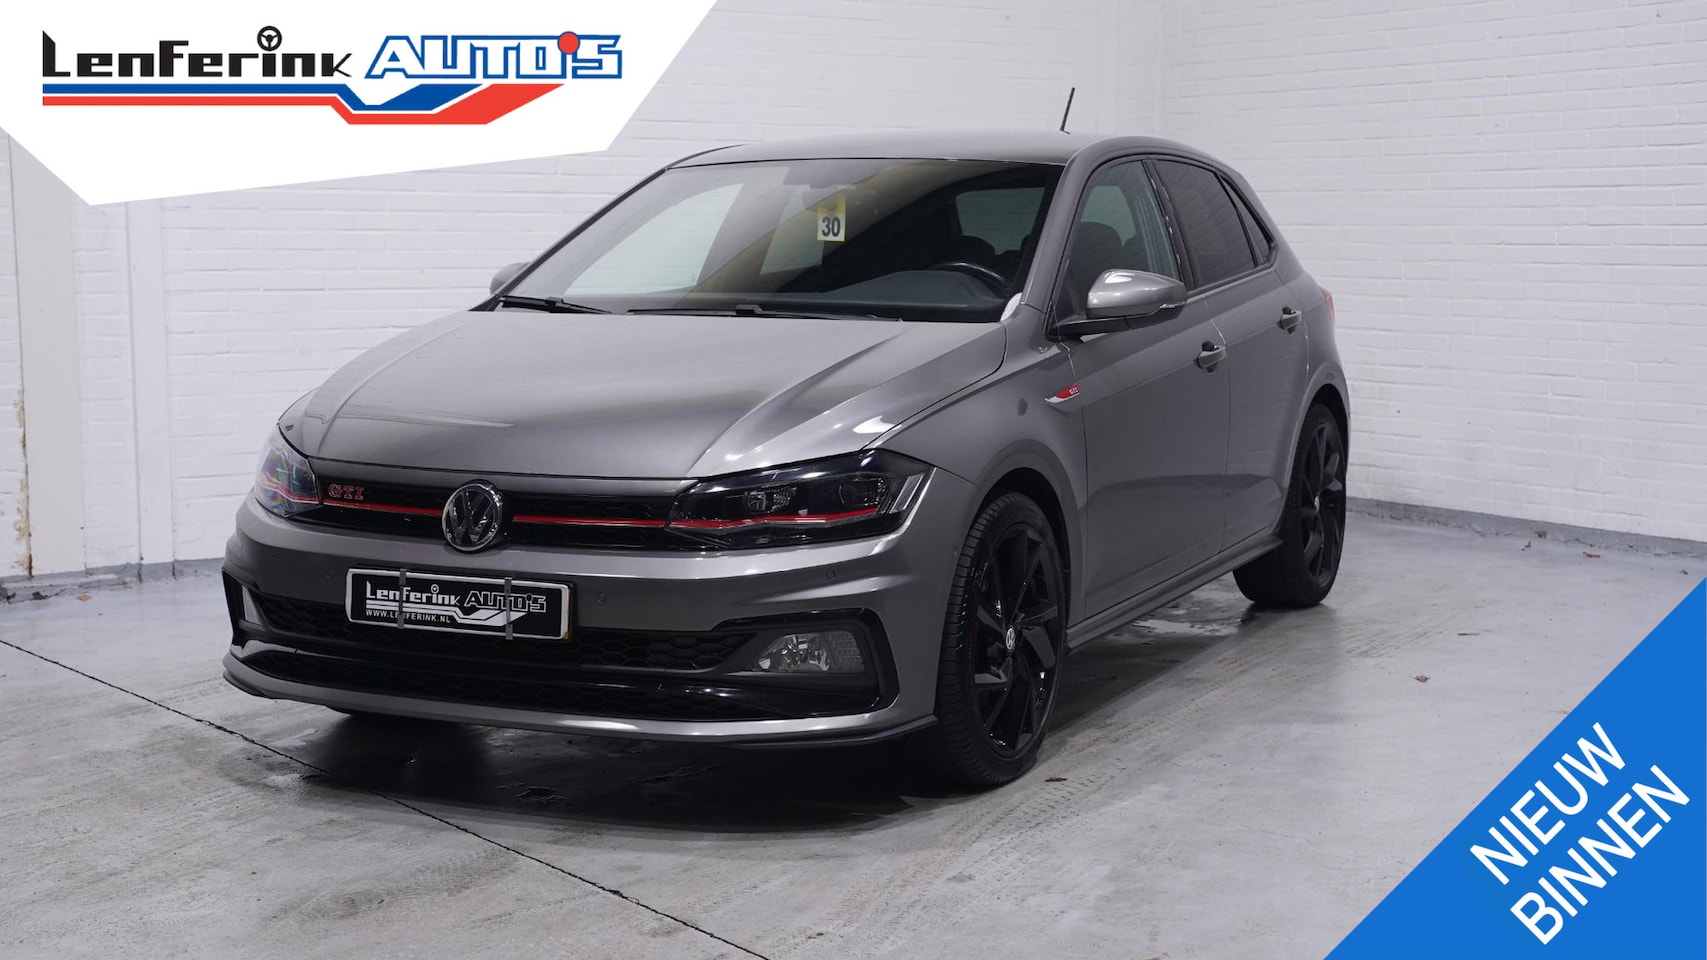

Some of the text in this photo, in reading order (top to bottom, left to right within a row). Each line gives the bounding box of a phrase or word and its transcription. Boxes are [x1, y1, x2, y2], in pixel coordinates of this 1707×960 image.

[821, 216, 841, 237] 30
[328, 483, 364, 500] GTI
[365, 609, 451, 623] WWW.LEFERINK.NL
